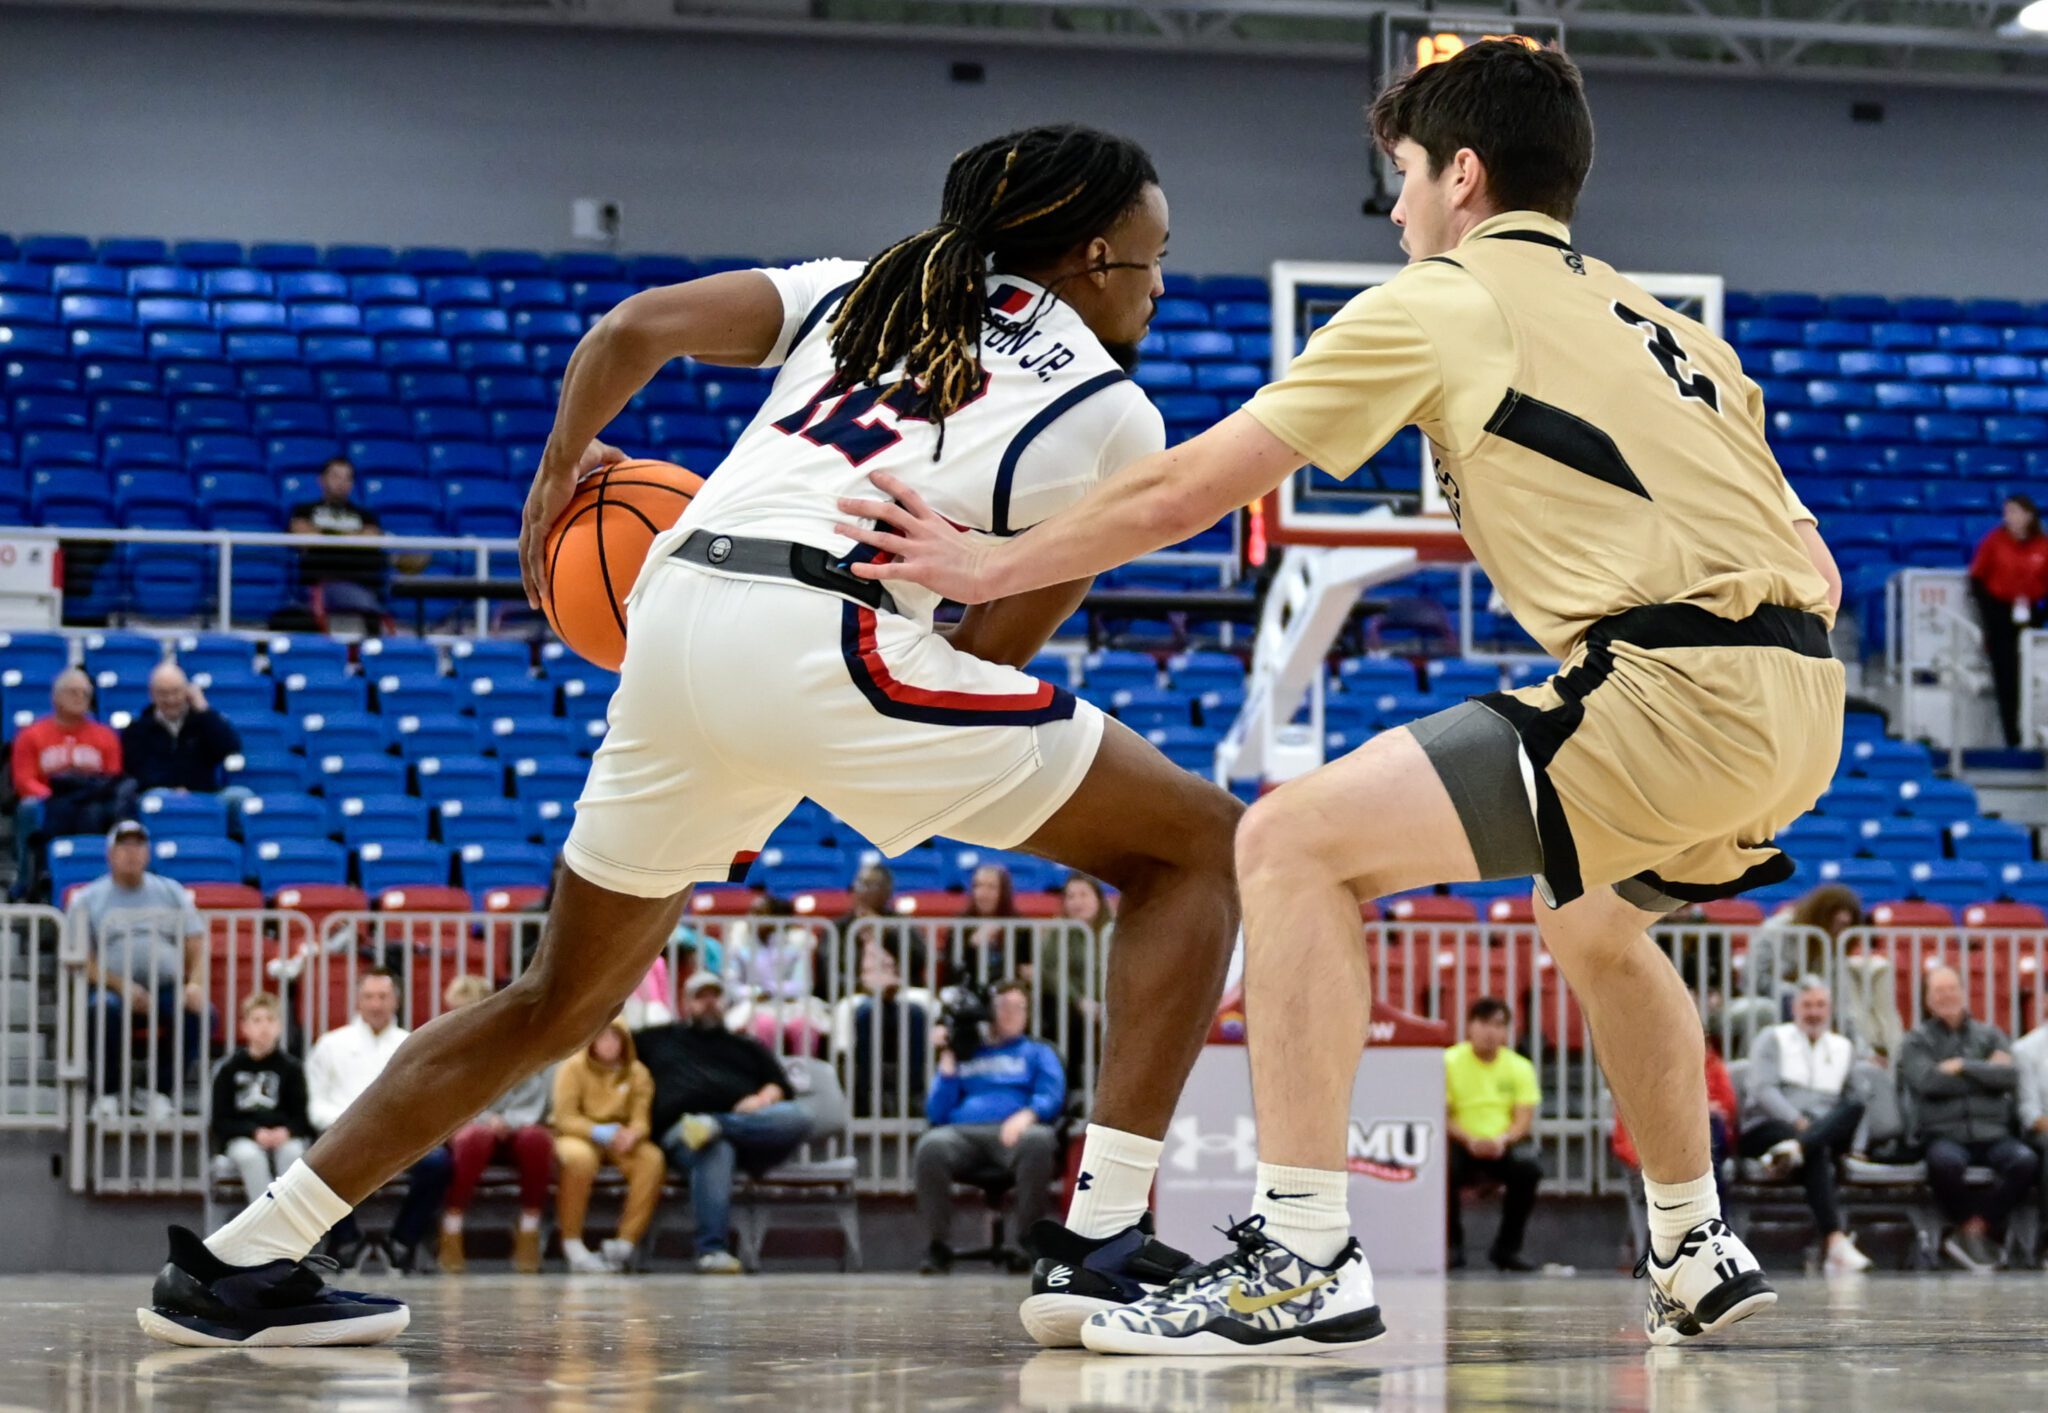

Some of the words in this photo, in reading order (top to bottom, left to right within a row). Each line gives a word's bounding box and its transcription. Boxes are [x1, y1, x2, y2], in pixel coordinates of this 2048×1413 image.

[1018, 342, 1075, 383] JR.
[1609, 298, 1724, 417] 2
[1712, 1242, 1724, 1257] 2
